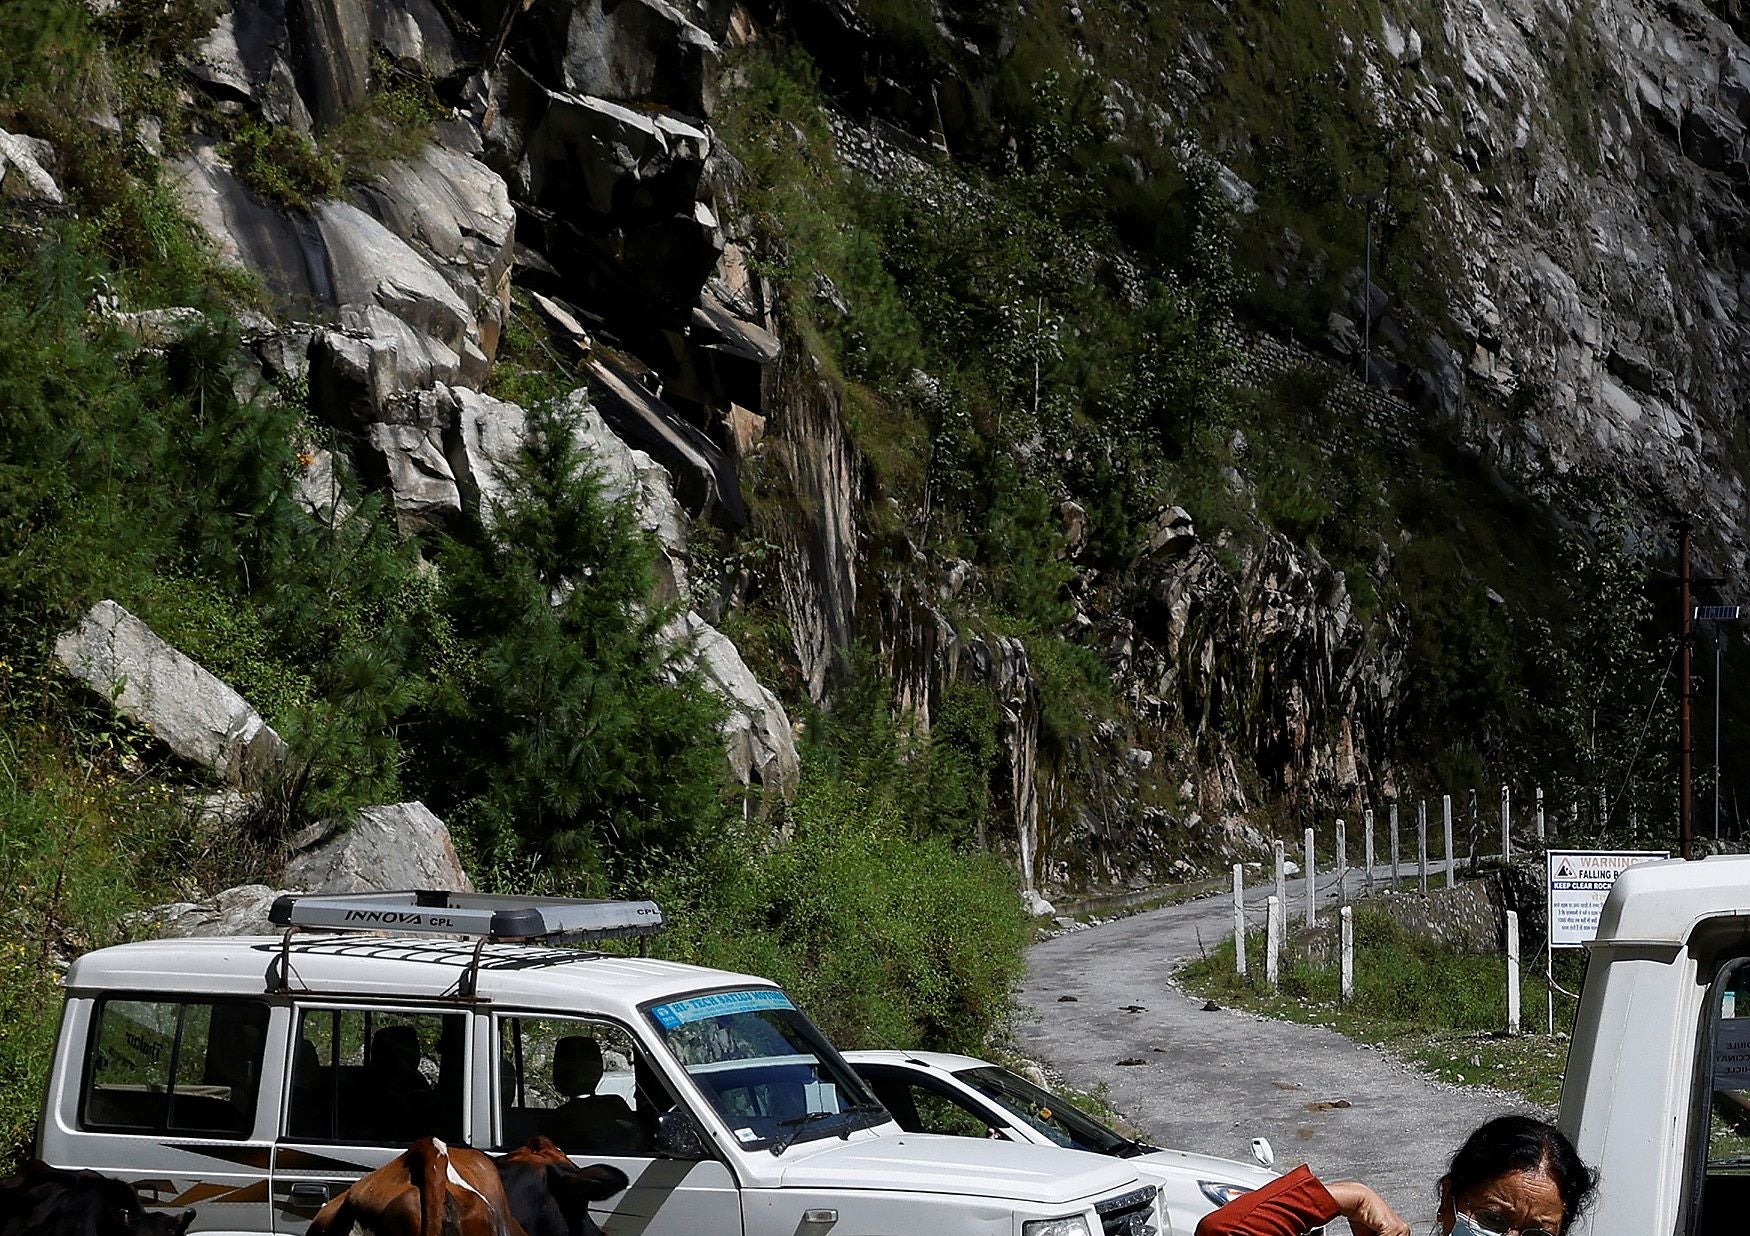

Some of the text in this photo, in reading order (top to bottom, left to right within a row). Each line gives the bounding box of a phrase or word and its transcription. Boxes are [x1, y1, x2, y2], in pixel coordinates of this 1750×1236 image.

[1579, 870, 1611, 880] FALLING
[1553, 882, 1571, 890] KEEP
[1572, 882, 1593, 890] CLEAR
[636, 908, 660, 916] CPL
[344, 910, 454, 927] INNOVA CPL
[691, 995, 717, 1008] TECH
